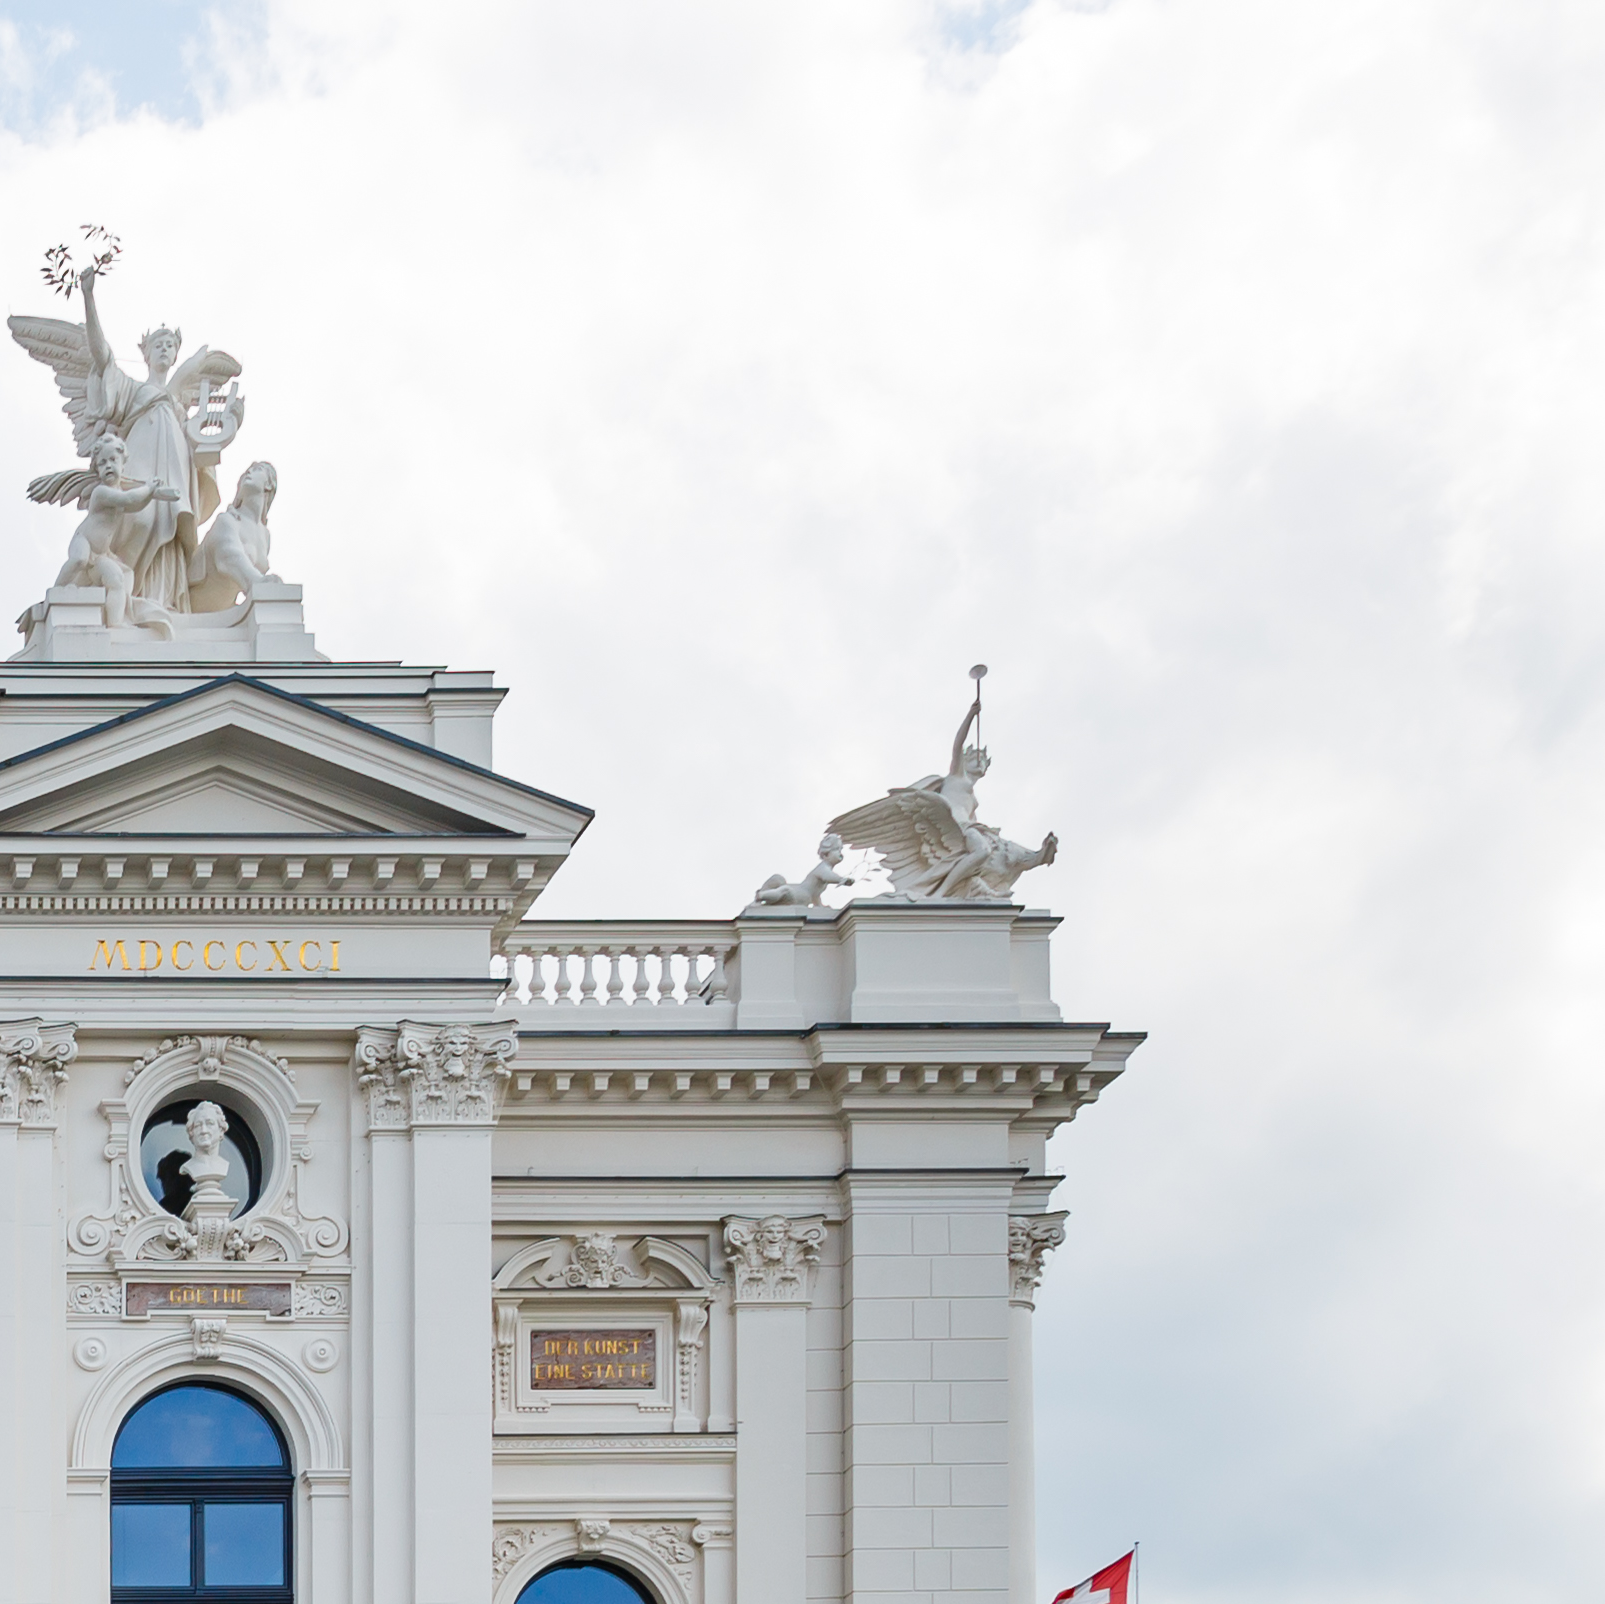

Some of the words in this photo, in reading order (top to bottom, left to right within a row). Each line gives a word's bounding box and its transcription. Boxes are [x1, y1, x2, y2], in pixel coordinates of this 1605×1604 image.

[87, 939, 341, 972] MDCCCXCI
[168, 1287, 248, 1304] GOETHE
[544, 1340, 579, 1356] DER
[584, 1340, 641, 1355] KUNST
[535, 1363, 576, 1380] EINE
